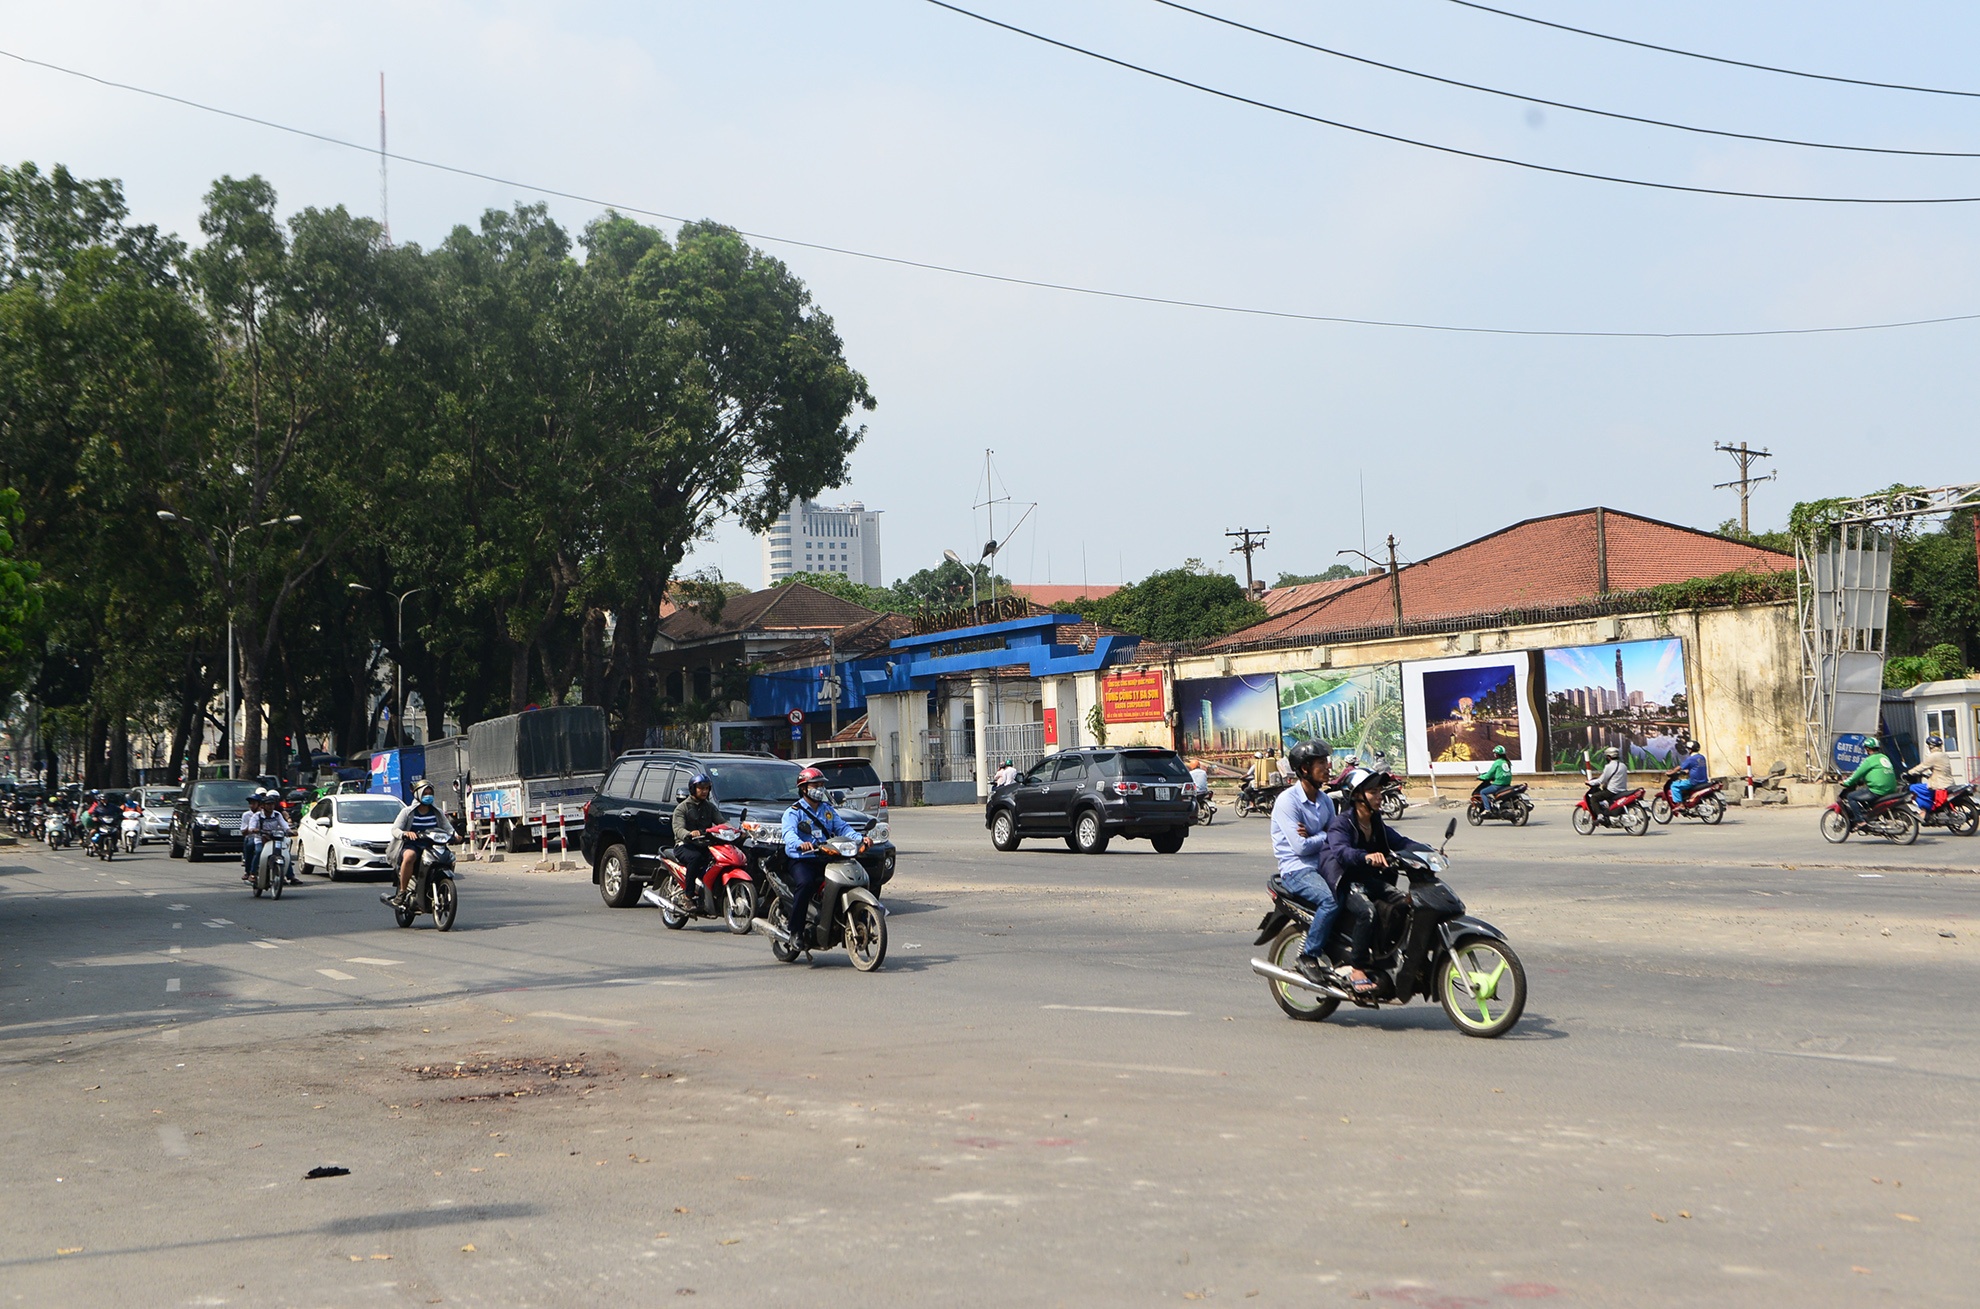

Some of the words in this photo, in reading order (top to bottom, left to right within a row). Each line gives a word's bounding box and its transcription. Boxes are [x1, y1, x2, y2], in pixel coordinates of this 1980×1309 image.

[986, 602, 1003, 624] BA
[1119, 689, 1133, 701] CÔNG
[1133, 690, 1139, 700] TY
[1140, 690, 1148, 700] BA
[1837, 742, 1853, 752] GATE
